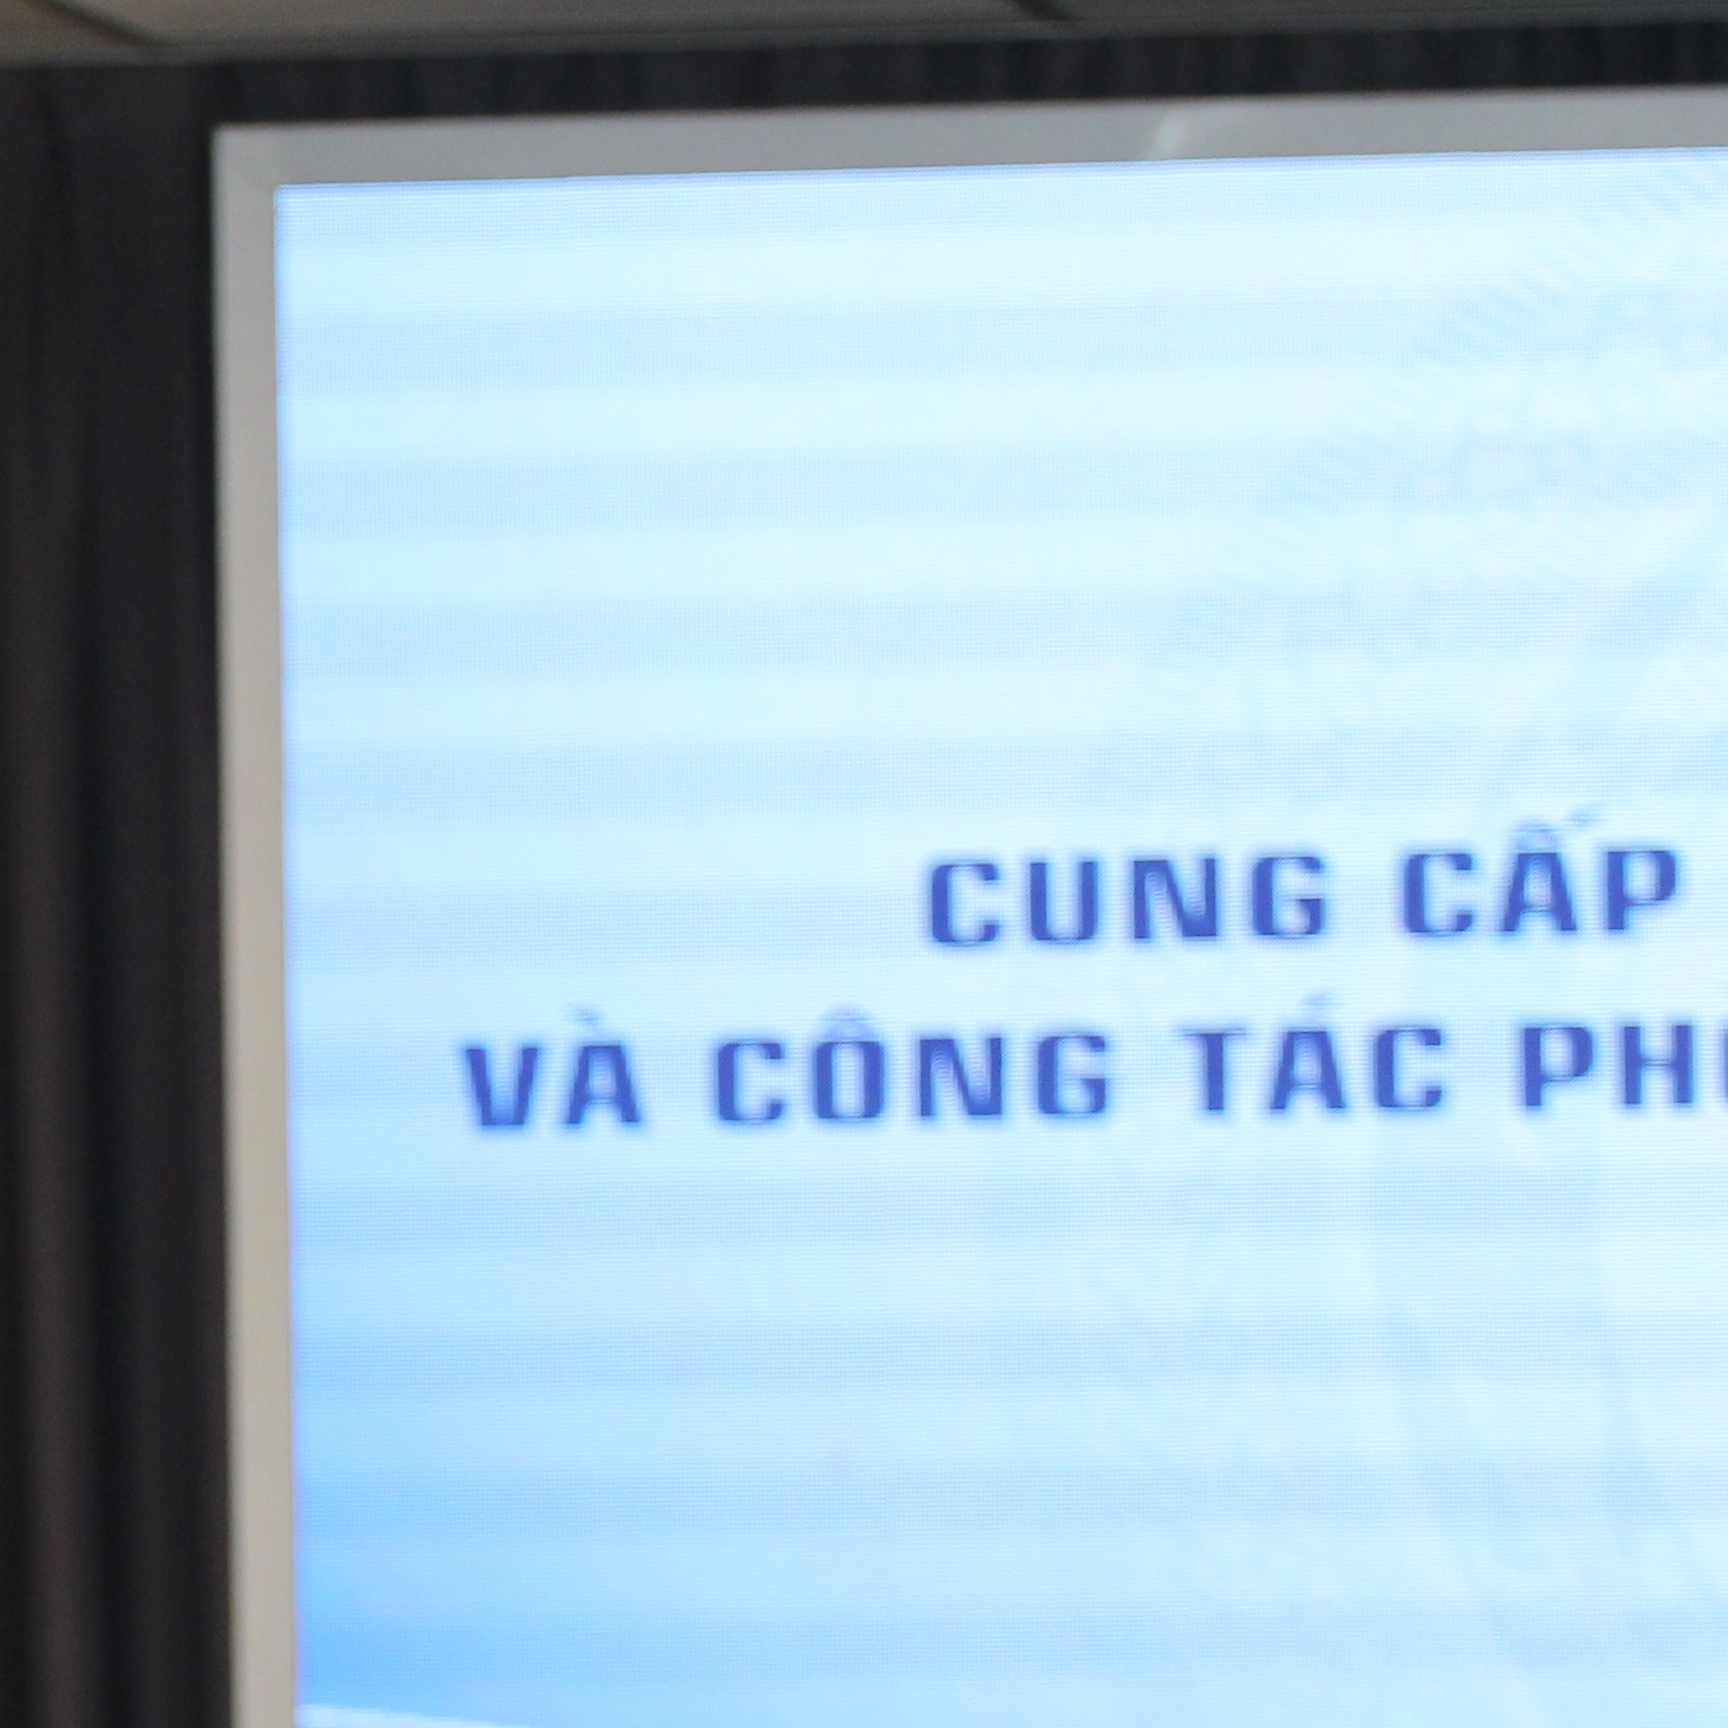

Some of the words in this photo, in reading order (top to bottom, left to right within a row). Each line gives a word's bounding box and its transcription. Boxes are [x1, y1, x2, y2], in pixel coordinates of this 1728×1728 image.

[927, 855, 1327, 945] CUNG
[1401, 806, 1678, 938] CẤP
[463, 1008, 643, 1129] VÀ
[714, 1008, 1110, 1122] CÔNG
[1182, 994, 1444, 1116] TÁC
[1523, 1023, 1728, 1109] PH
